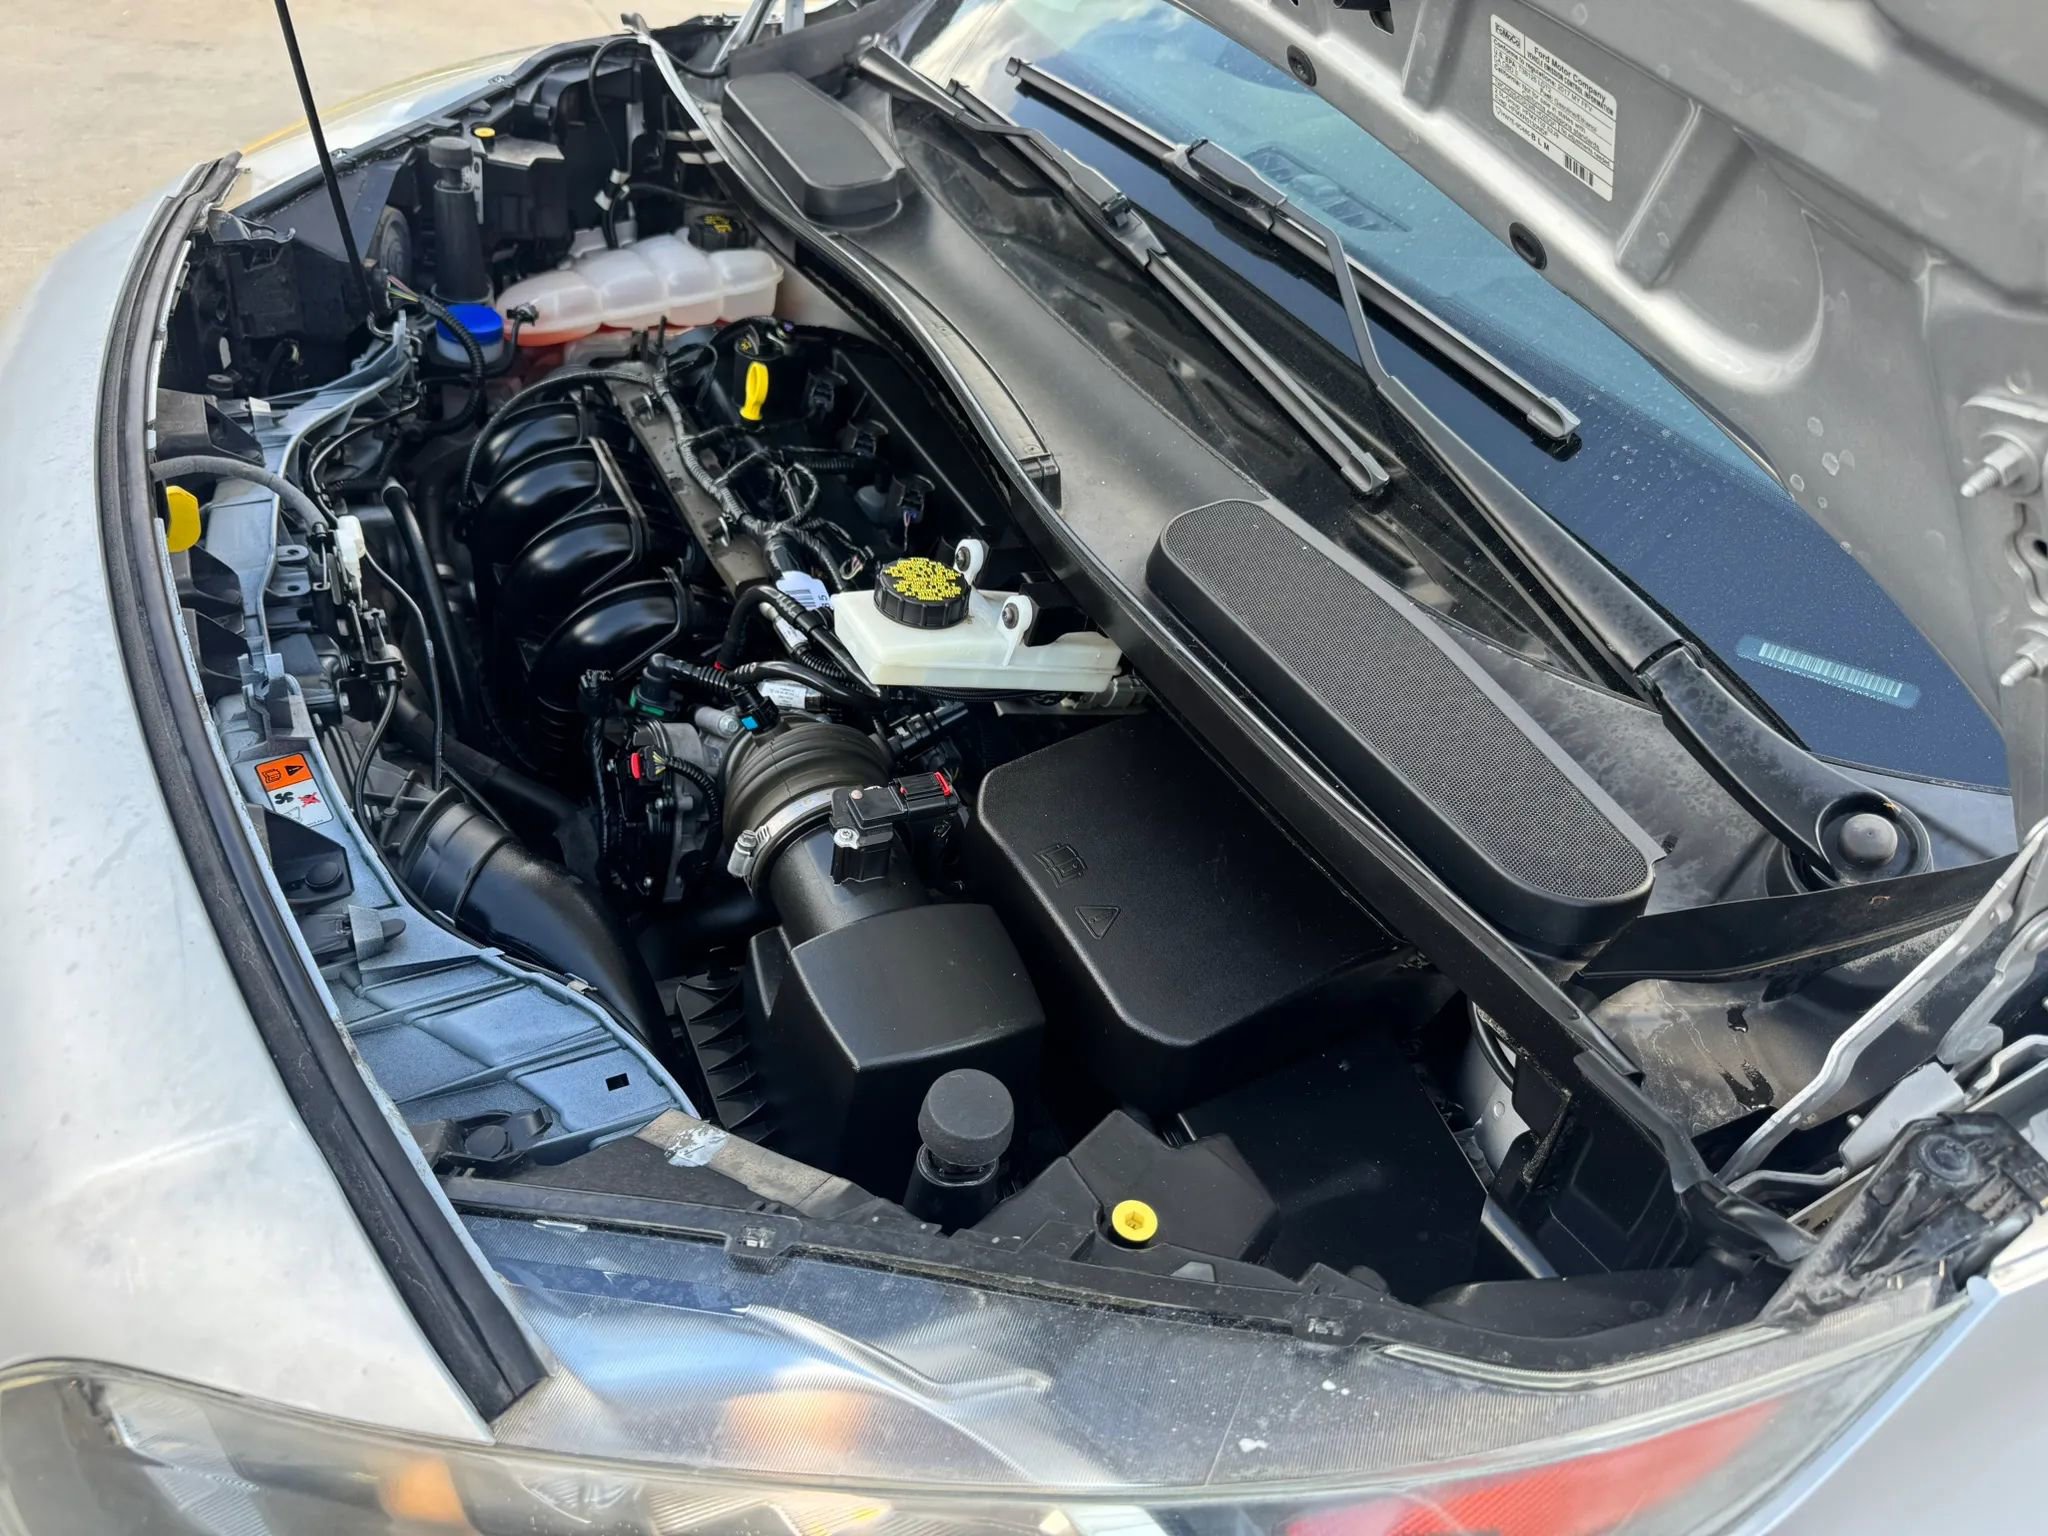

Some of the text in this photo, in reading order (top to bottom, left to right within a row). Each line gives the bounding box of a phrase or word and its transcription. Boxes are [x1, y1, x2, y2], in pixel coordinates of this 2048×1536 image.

[1527, 50, 1613, 116] VEHICLE EMISSION CONTROL INFORMATION
[1534, 45, 1605, 103] Ford Motor Company
[1557, 83, 1570, 97] 2017
[1537, 137, 1542, 147] L
[1543, 141, 1549, 152] M
